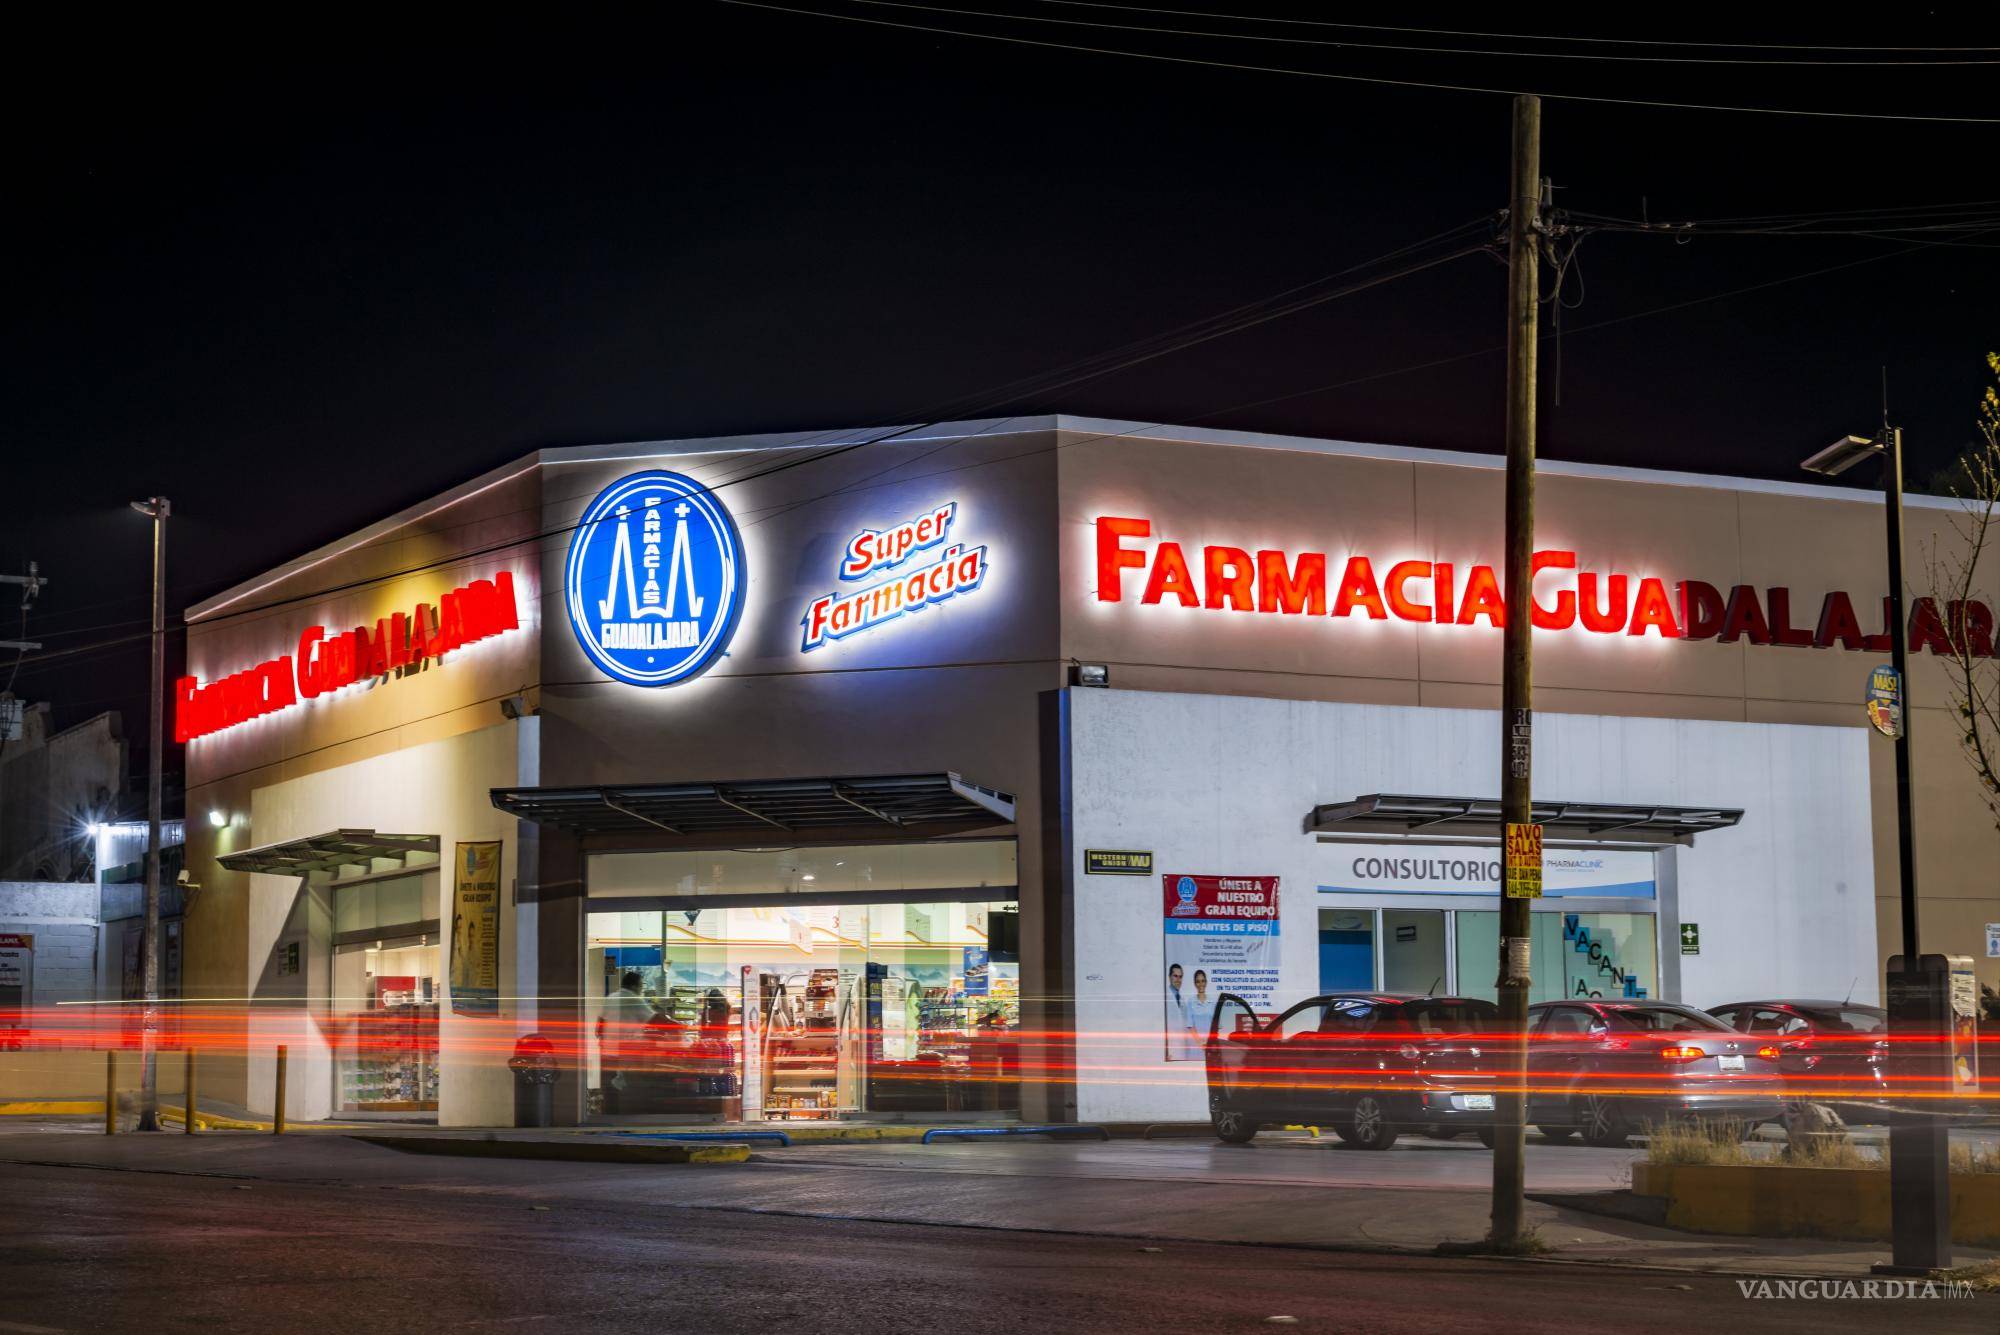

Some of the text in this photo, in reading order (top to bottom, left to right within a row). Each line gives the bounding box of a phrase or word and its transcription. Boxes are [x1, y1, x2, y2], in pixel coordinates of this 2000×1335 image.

[643, 497, 662, 604] FARMACIAS
[848, 508, 950, 573] Super
[810, 546, 979, 641] Farmacia
[1096, 516, 2000, 659] FARMACIA GUADALAJAR
[601, 620, 700, 650] GUADALAJARA
[1507, 824, 1541, 840] LAVO
[1507, 840, 1542, 856] SALAS
[1352, 856, 1501, 883] CONSULTORIO
[1253, 880, 1262, 890] A
[1217, 892, 1264, 903] NUESTRO
[1205, 905, 1236, 916] GRAN
[1237, 905, 1275, 918] EQUIPO
[1176, 923, 1231, 932] AYUDANTES
[1232, 923, 1245, 932] DE
